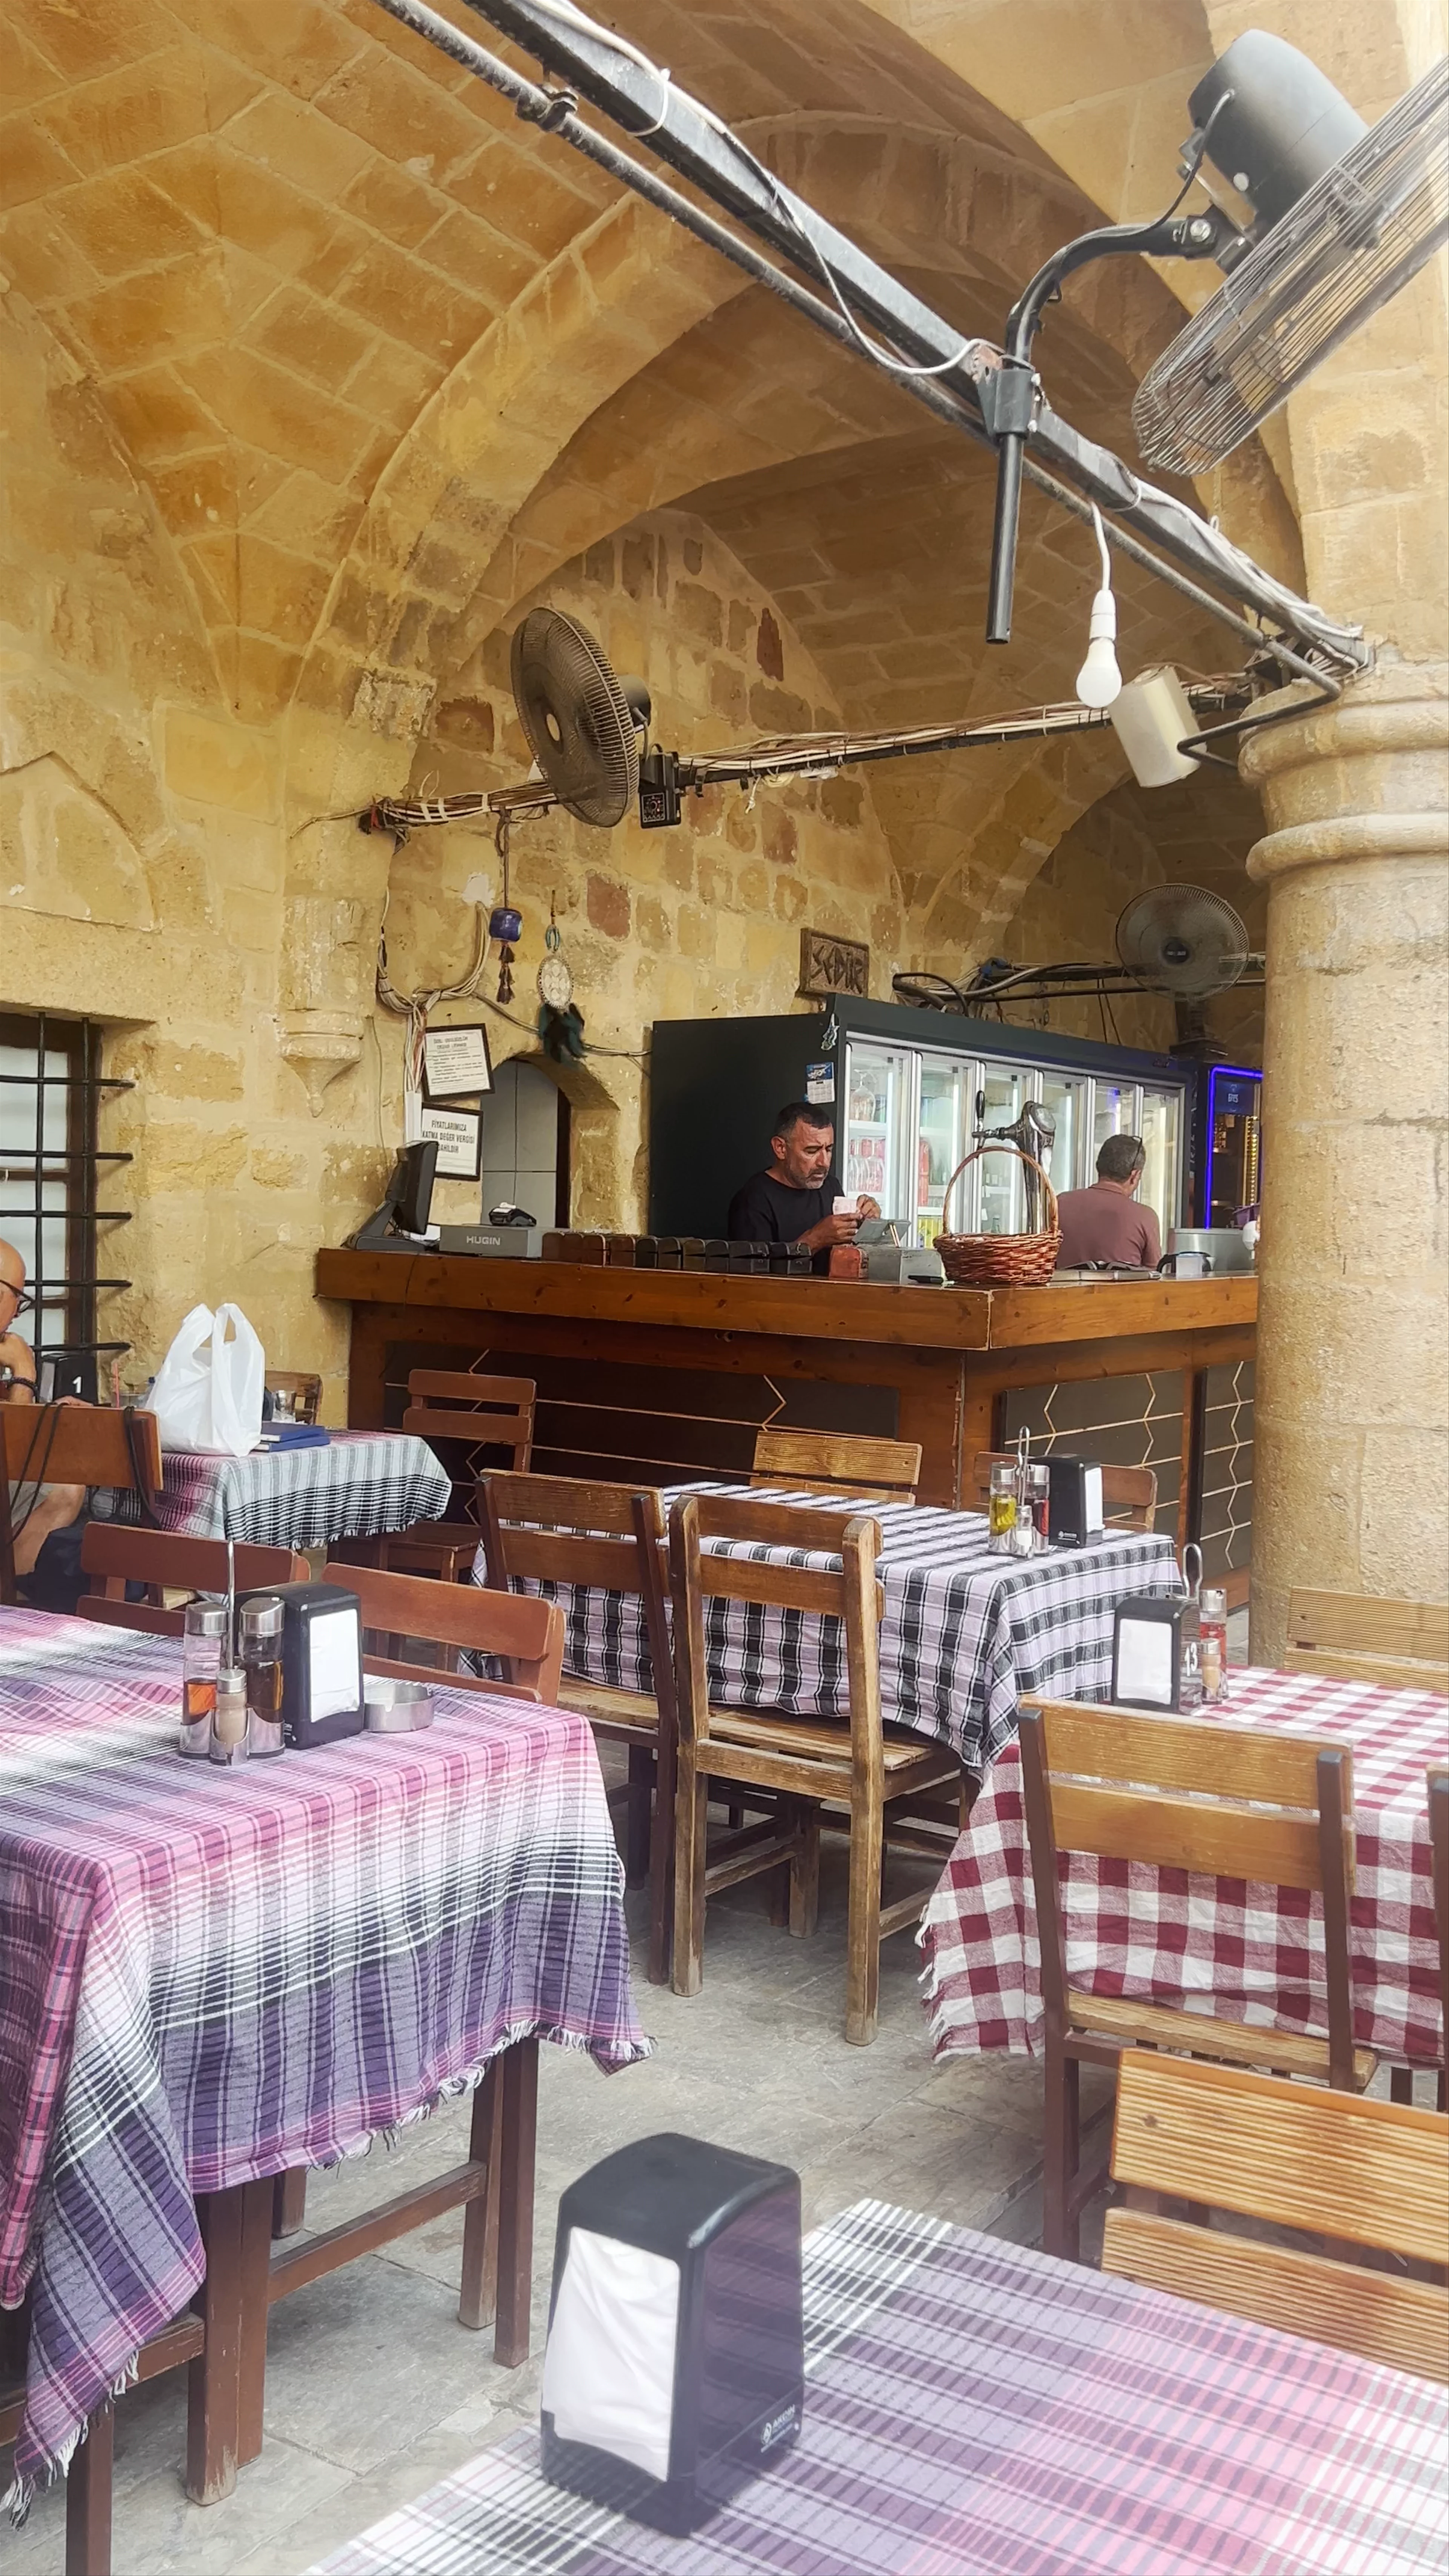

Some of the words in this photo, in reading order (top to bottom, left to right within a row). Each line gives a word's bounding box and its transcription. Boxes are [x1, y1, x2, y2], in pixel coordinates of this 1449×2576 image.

[432, 1119, 467, 1132] FİYATLARIMIZA
[422, 1130, 438, 1139] KATMA
[440, 1132, 455, 1142] DEĞER
[438, 1143, 459, 1153] AHİLDİR
[466, 1236, 501, 1246] HUGIN
[72, 1376, 82, 1393] 1
[1184, 1642, 1198, 1676] 13
